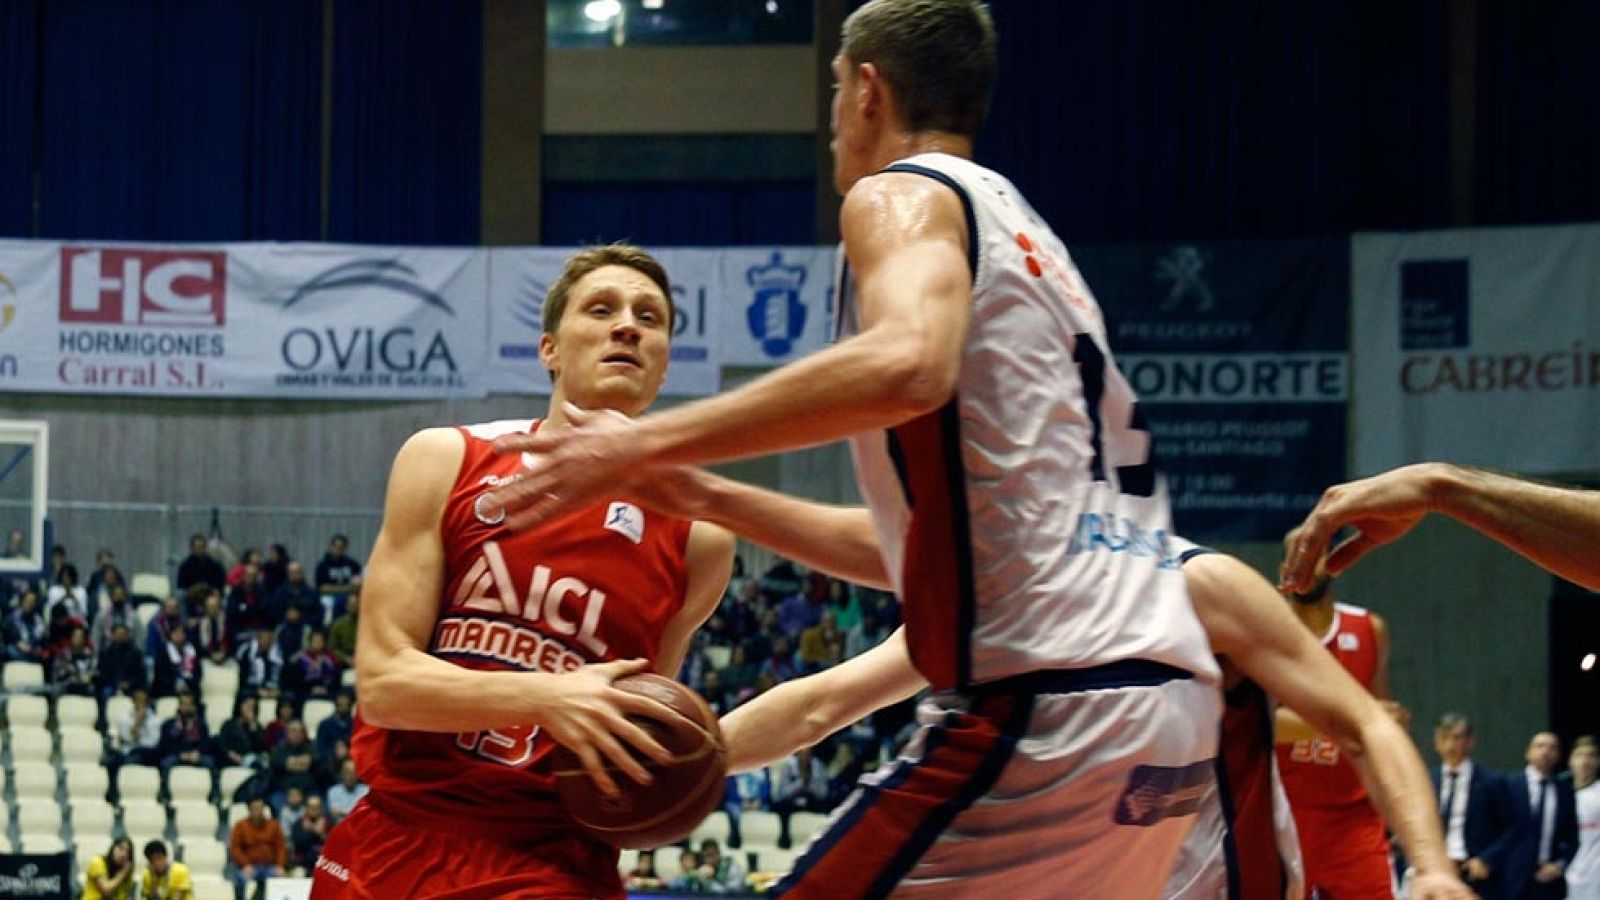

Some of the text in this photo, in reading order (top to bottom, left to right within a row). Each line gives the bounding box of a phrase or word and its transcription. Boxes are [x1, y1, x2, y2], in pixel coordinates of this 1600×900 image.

[71, 251, 216, 324] HC
[58, 331, 225, 357] HORMIGONES
[281, 327, 458, 372] OVIGA
[58, 357, 157, 387] Carral
[1117, 357, 1342, 397] ONORTE
[522, 564, 608, 656] ICL
[437, 618, 587, 674] MANRES
